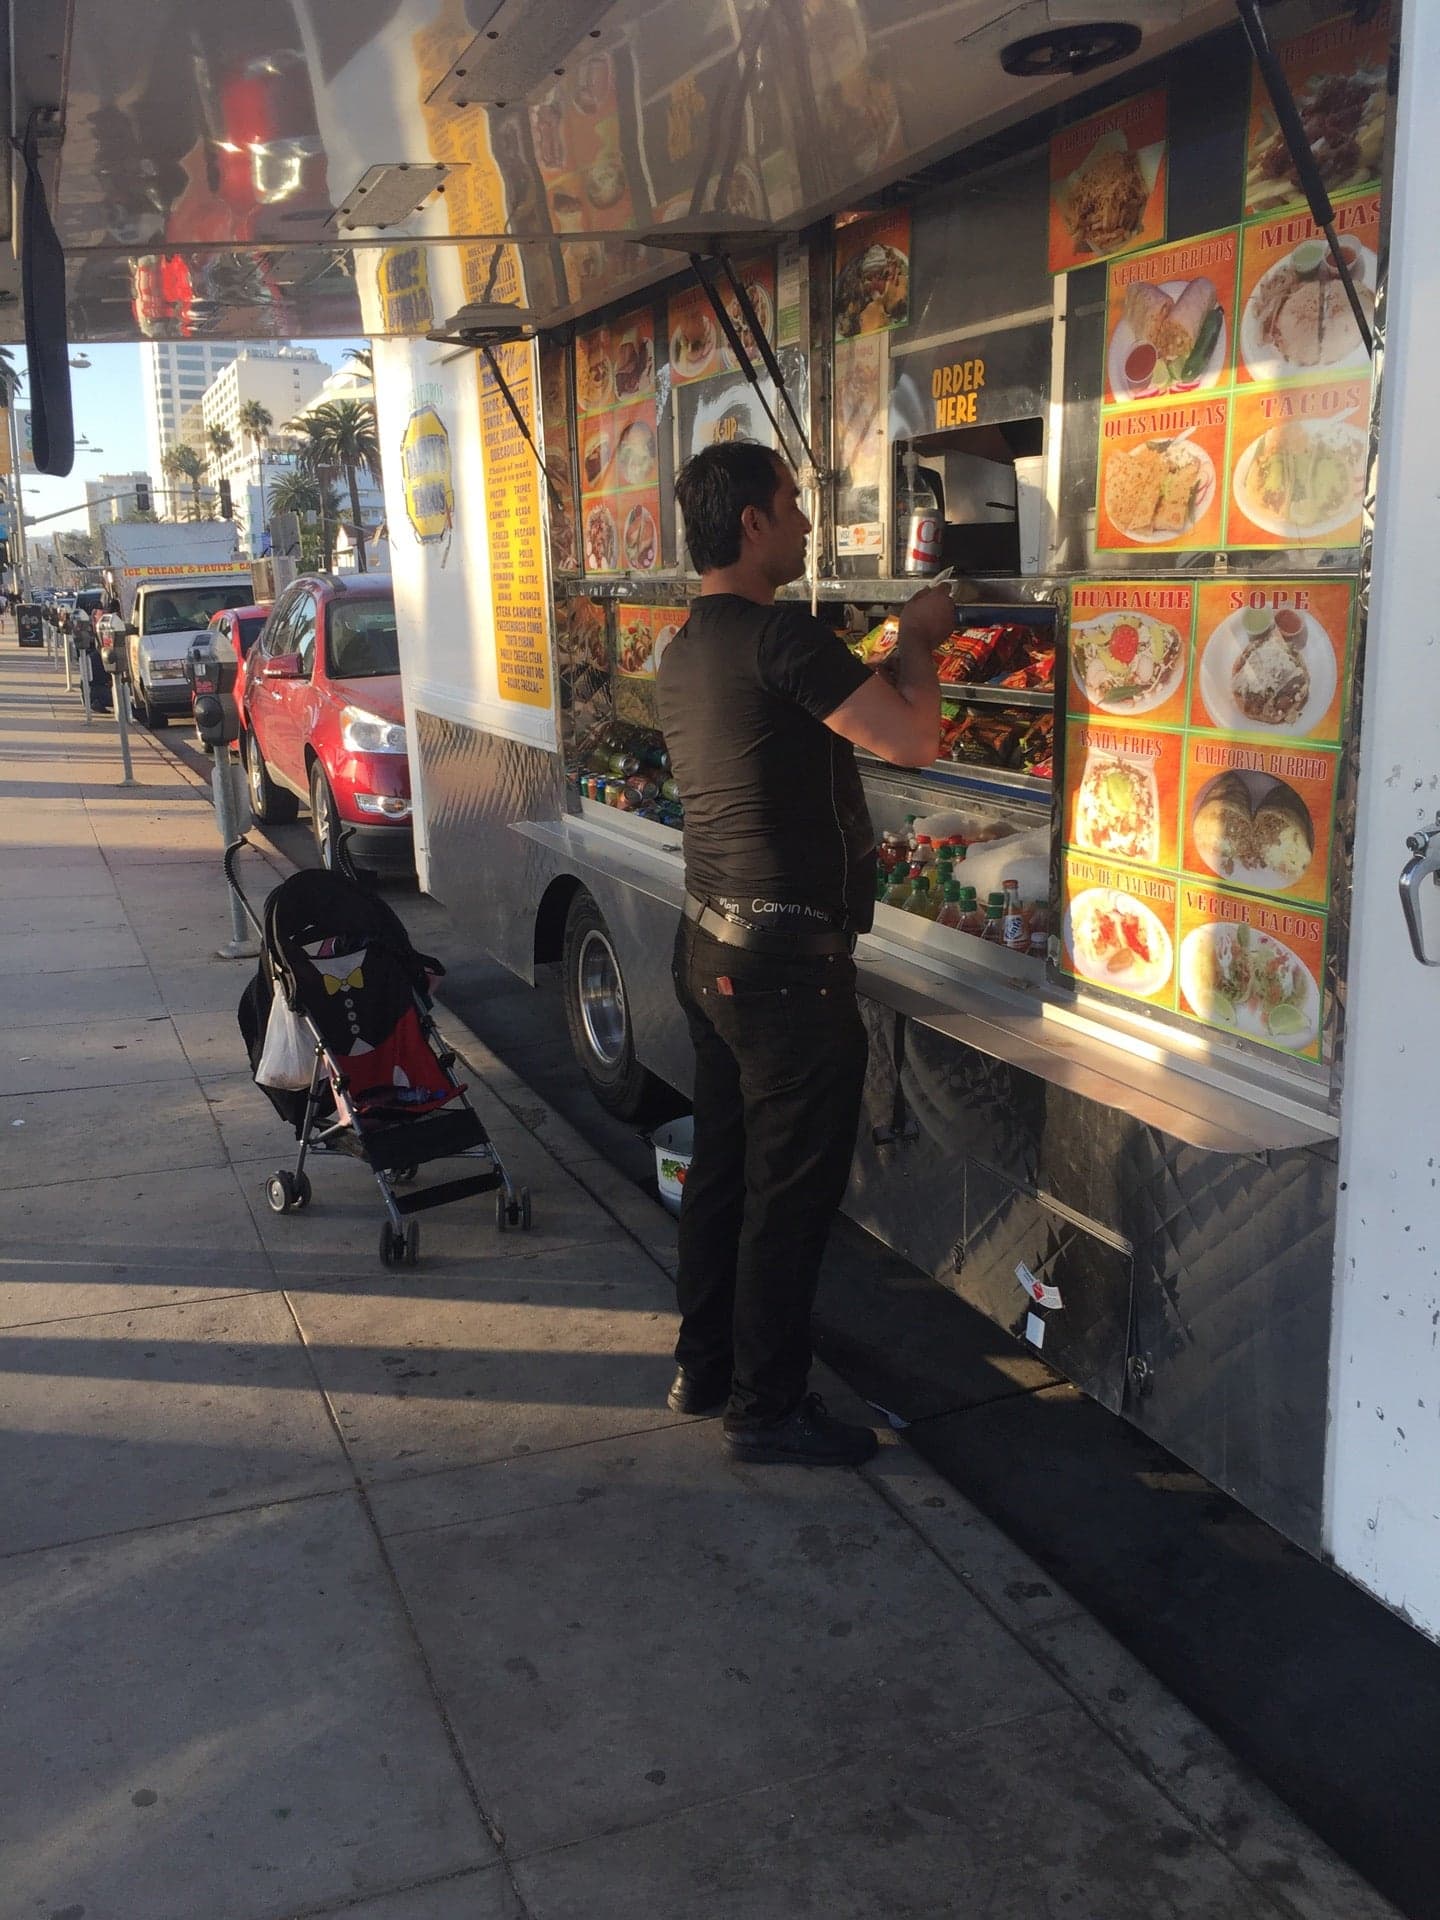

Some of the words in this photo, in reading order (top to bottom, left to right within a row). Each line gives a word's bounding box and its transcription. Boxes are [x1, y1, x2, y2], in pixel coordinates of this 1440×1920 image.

[1259, 199, 1380, 250] MULTAS
[1111, 258, 1158, 287] VEGGIE
[1162, 239, 1233, 276] BURRITOS
[931, 358, 986, 399] ORDER
[935, 391, 978, 432] HERE
[1260, 386, 1361, 418] TACOS
[1103, 404, 1226, 440] QUESADILLAS
[124, 566, 141, 577] ICE
[147, 565, 184, 575] CREAM
[199, 562, 234, 573] FRUITS
[1073, 589, 1190, 610] HUARACHE
[1228, 589, 1312, 610] SOPE
[1123, 735, 1163, 757] FRIES
[1194, 743, 1266, 773] CALIFORNIA
[1269, 752, 1328, 780] BURRITO
[751, 898, 801, 915] Calvin
[1185, 891, 1251, 924] VEGGIE
[1258, 909, 1321, 942] TACOS
